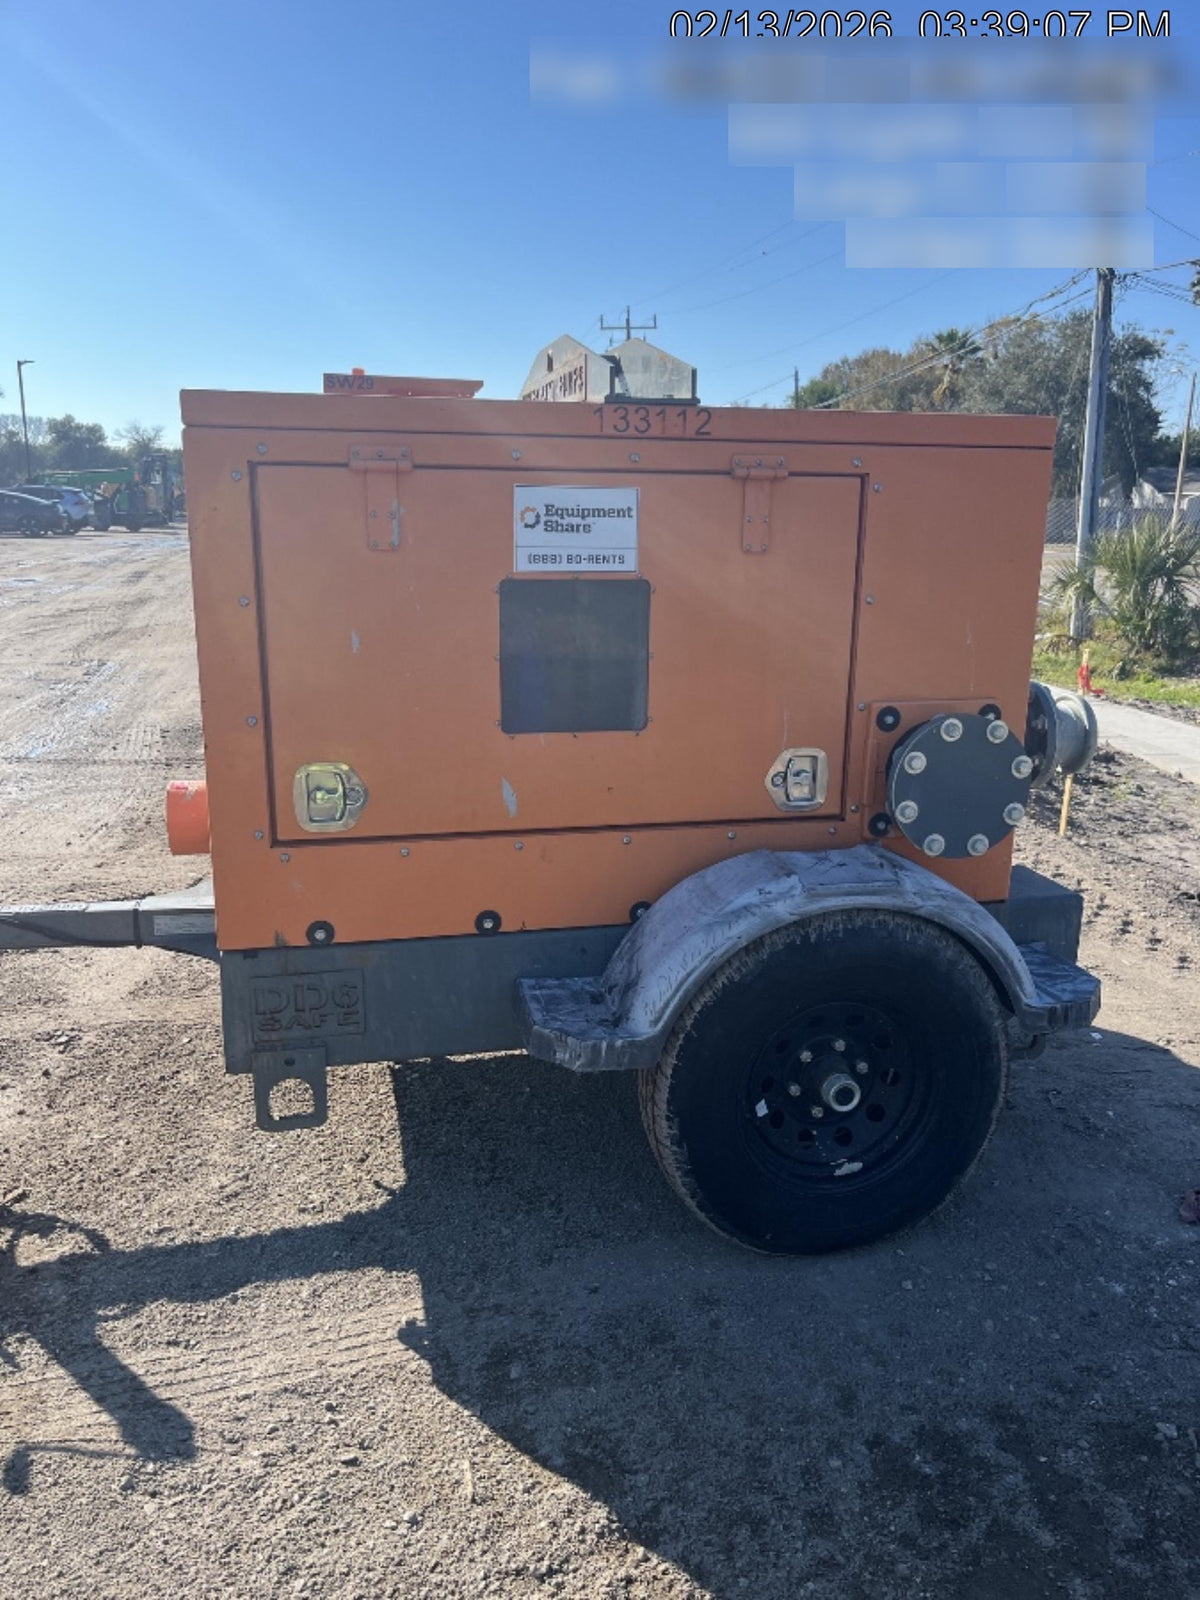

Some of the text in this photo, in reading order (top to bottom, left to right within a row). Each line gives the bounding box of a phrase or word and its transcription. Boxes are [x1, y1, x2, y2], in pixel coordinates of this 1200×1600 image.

[593, 406, 712, 435] 133112
[543, 504, 634, 520] Equipment
[543, 519, 593, 533] Share
[528, 554, 563, 564] (888)
[257, 1009, 361, 1032] SAFE
